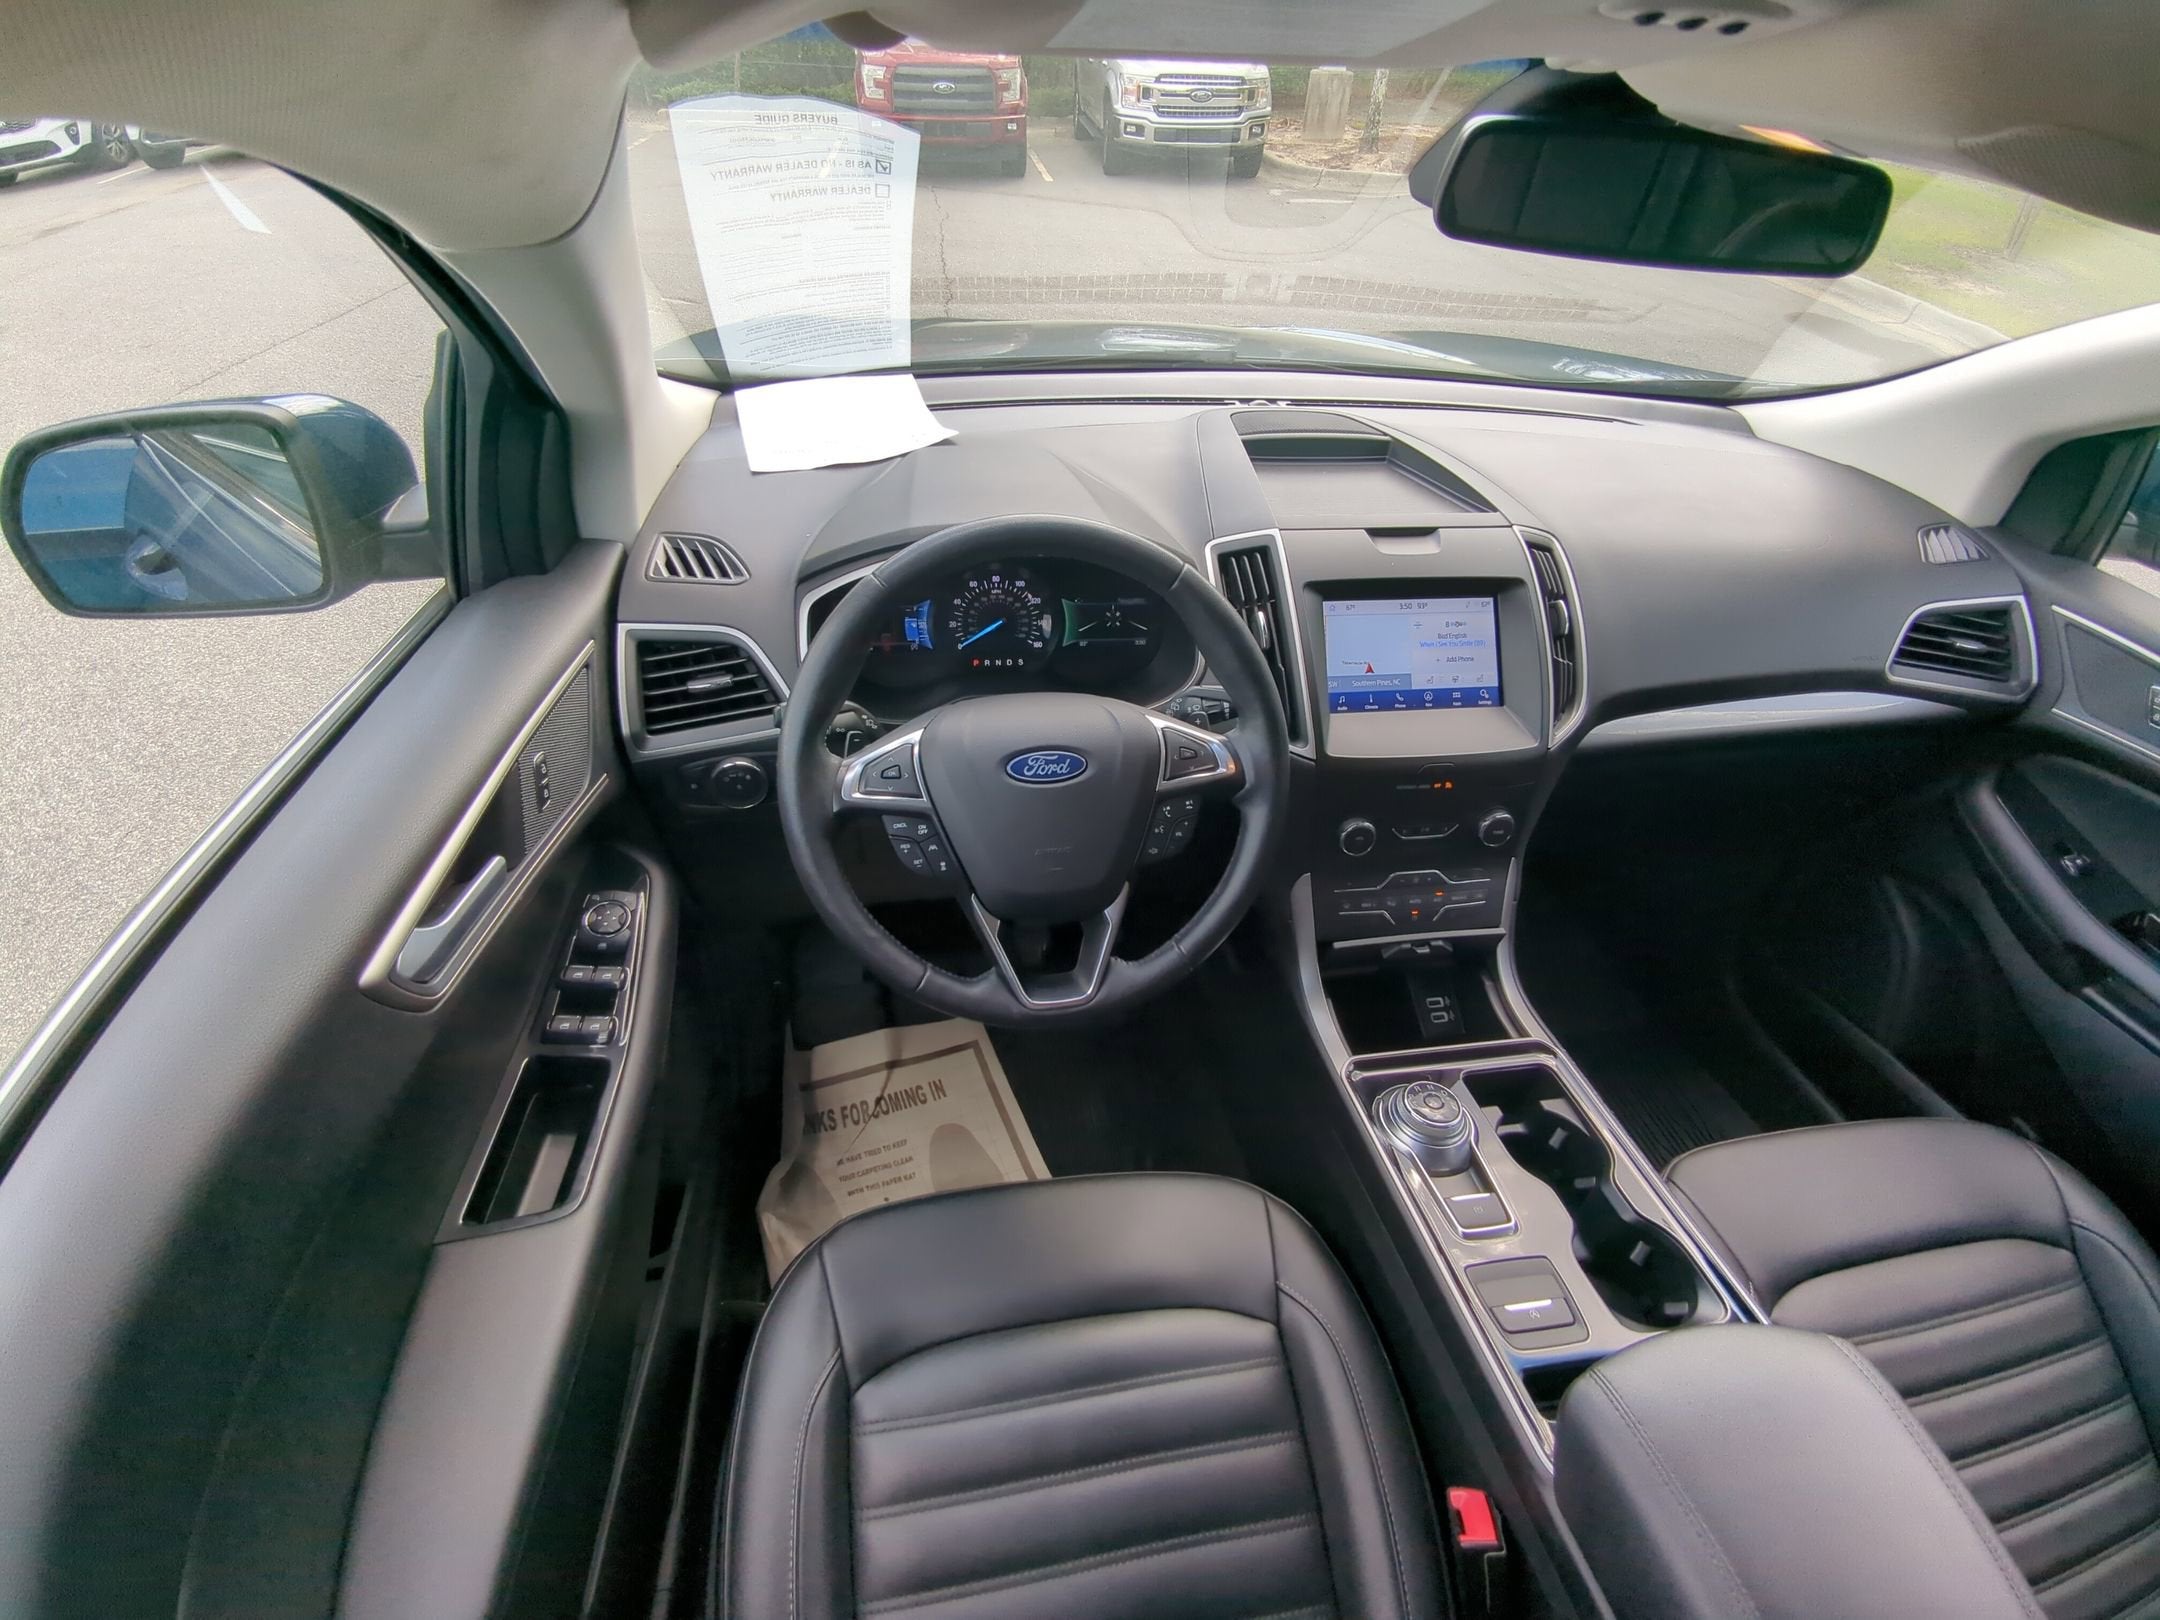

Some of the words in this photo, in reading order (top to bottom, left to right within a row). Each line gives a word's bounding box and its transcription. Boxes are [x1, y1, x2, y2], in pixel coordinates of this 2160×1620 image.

[1015, 580, 1026, 588] 100
[1018, 658, 1024, 666] S
[1352, 680, 1376, 688] Southern
[1393, 678, 1400, 686] NC
[1024, 753, 1070, 777] Ford
[840, 1100, 870, 1129] FOR
[872, 1084, 928, 1119] COMING
[928, 1079, 948, 1101] IN
[846, 1153, 862, 1164] HAVE
[864, 1146, 882, 1158] TRIED
[882, 1143, 891, 1152] TO
[892, 1138, 908, 1149] KEEP
[838, 1173, 856, 1183] YOUR
[857, 1162, 892, 1177] CARPETING
[892, 1156, 914, 1167] CLEAN
[847, 1186, 864, 1197] WITH
[865, 1182, 880, 1192] THIS
[882, 1175, 903, 1188] PAPER
